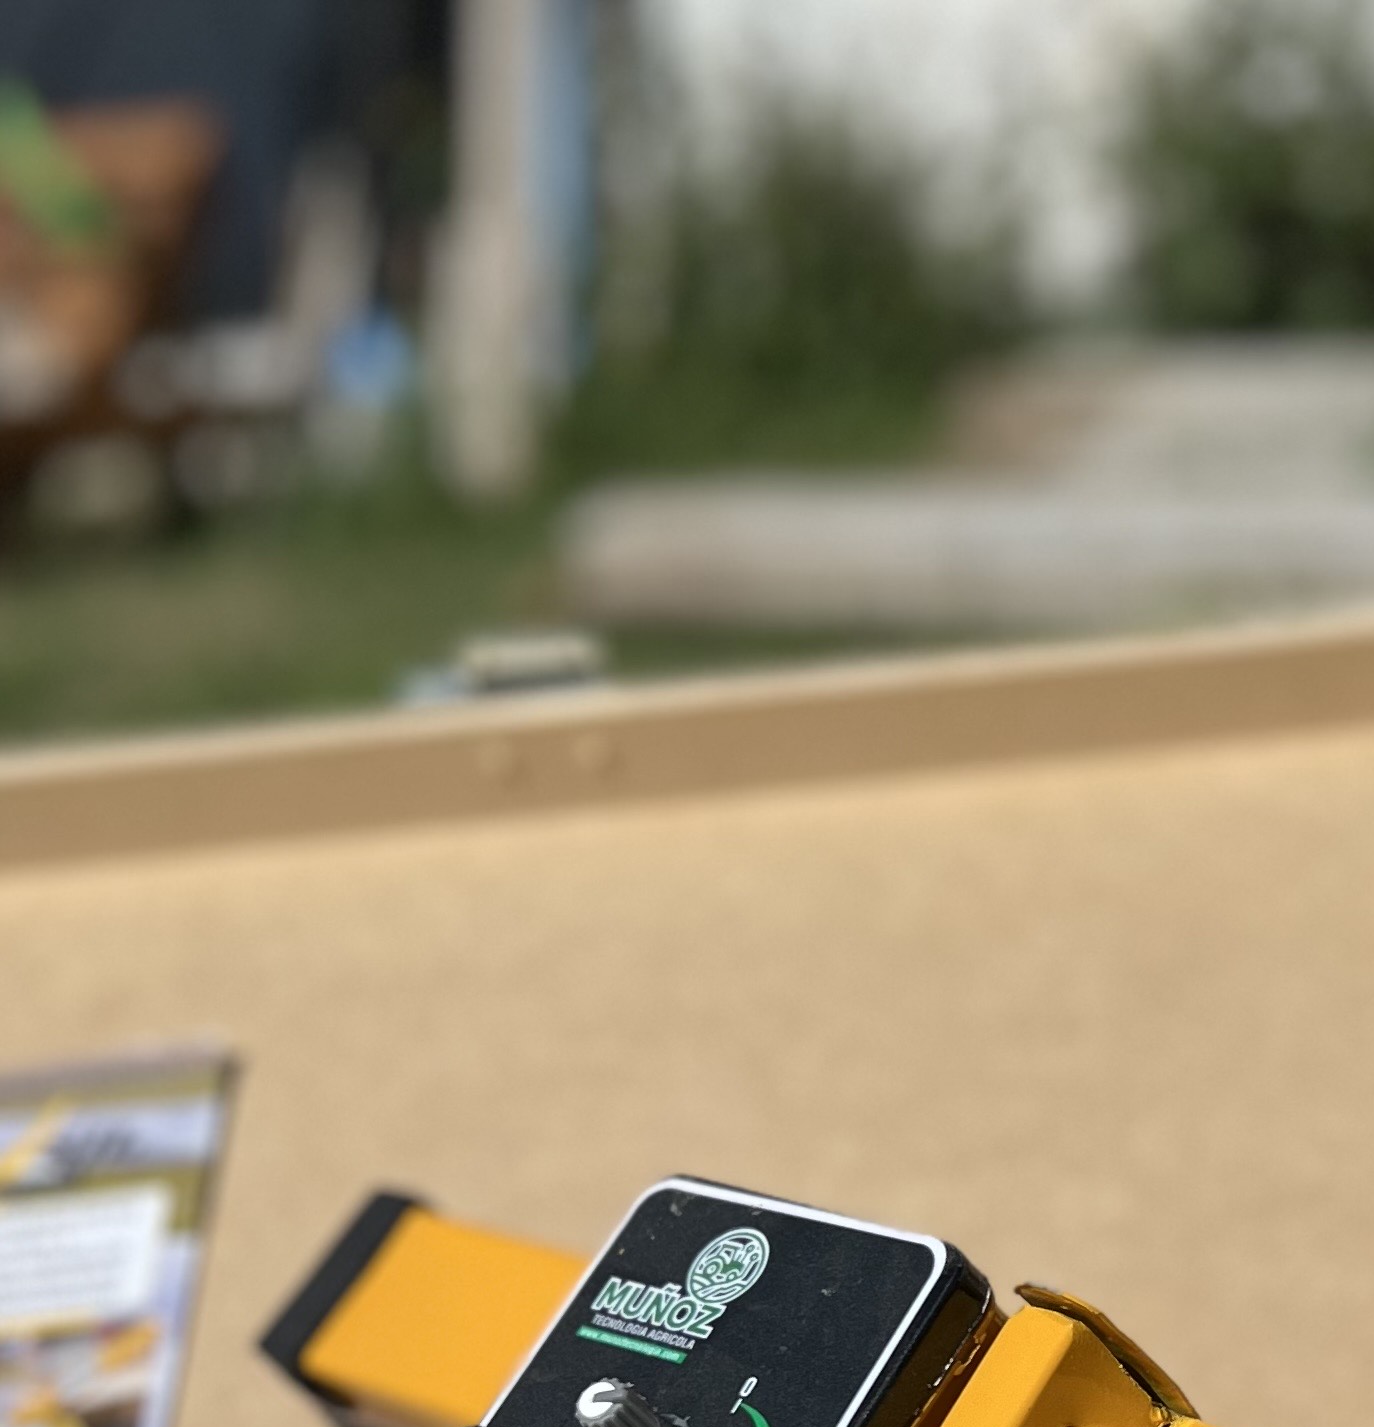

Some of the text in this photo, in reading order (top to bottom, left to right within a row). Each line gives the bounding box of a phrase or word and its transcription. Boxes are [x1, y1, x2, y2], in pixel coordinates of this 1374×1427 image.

[590, 1275, 728, 1340] MUÑOZ
[591, 1314, 648, 1338] TECNOLOGIA
[646, 1329, 697, 1350] AGRICOLA
[739, 1375, 758, 1398] 0
